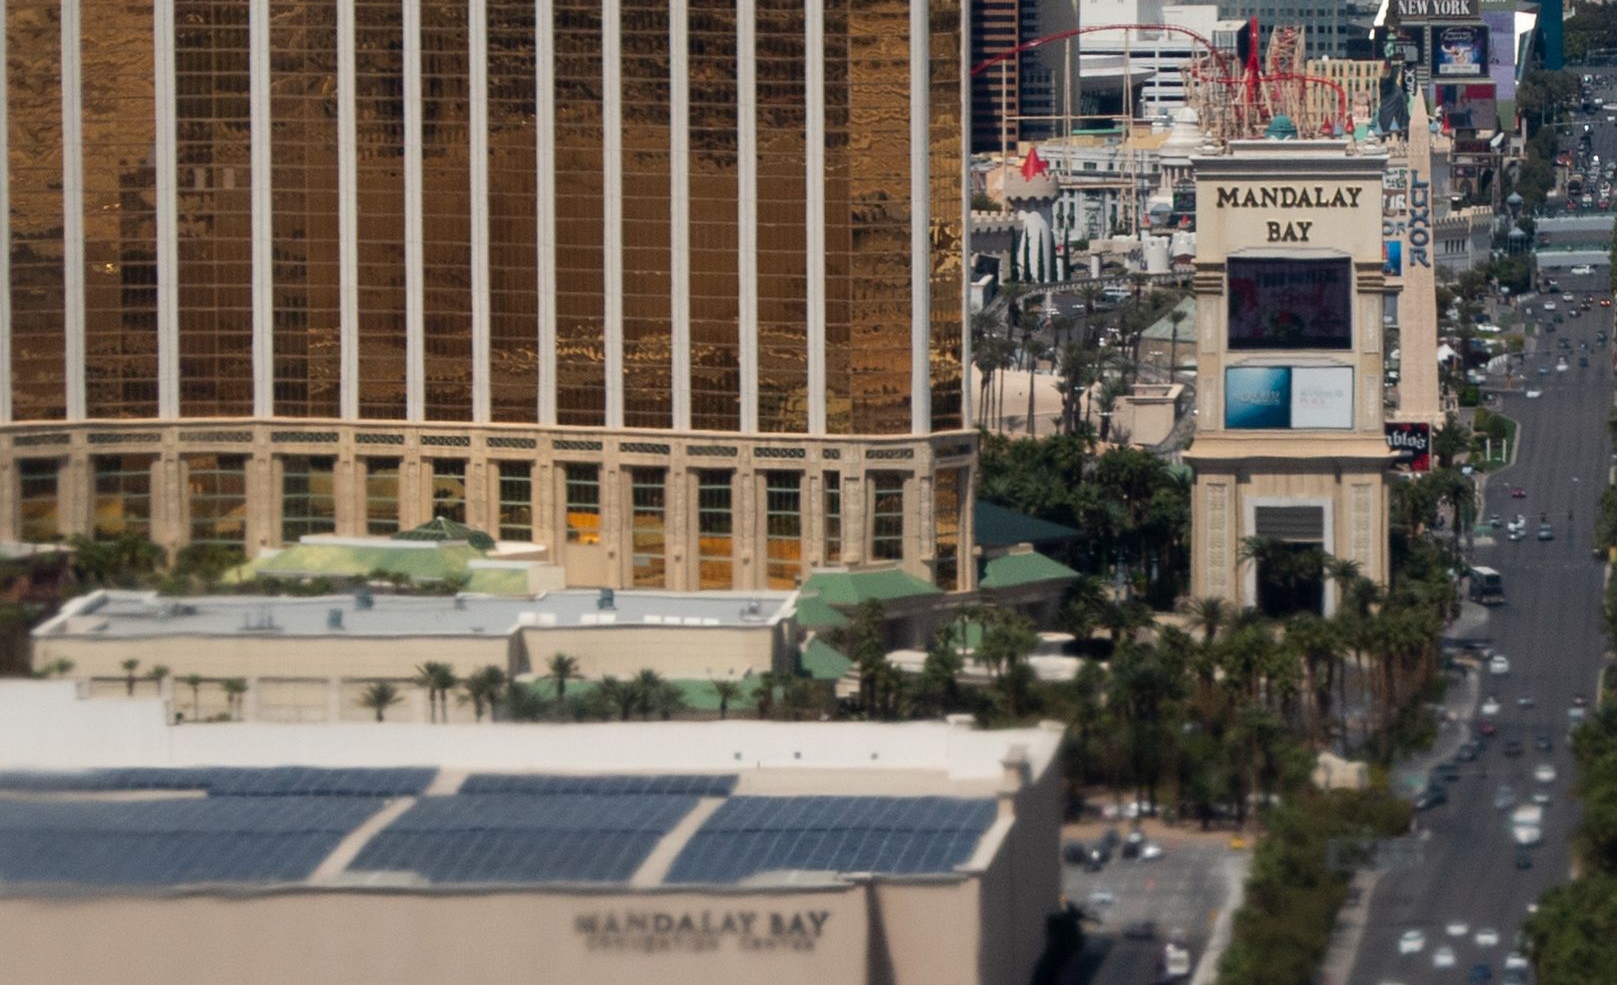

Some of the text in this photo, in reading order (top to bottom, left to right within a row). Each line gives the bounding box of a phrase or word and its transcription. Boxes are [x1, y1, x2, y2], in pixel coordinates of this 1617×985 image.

[1397, 0, 1471, 15] NEW YORK
[1216, 186, 1363, 209] MANDALAY
[1408, 169, 1431, 268] LUXOR
[1266, 221, 1313, 242] BAY
[573, 911, 831, 937] MANDALAY BAY
